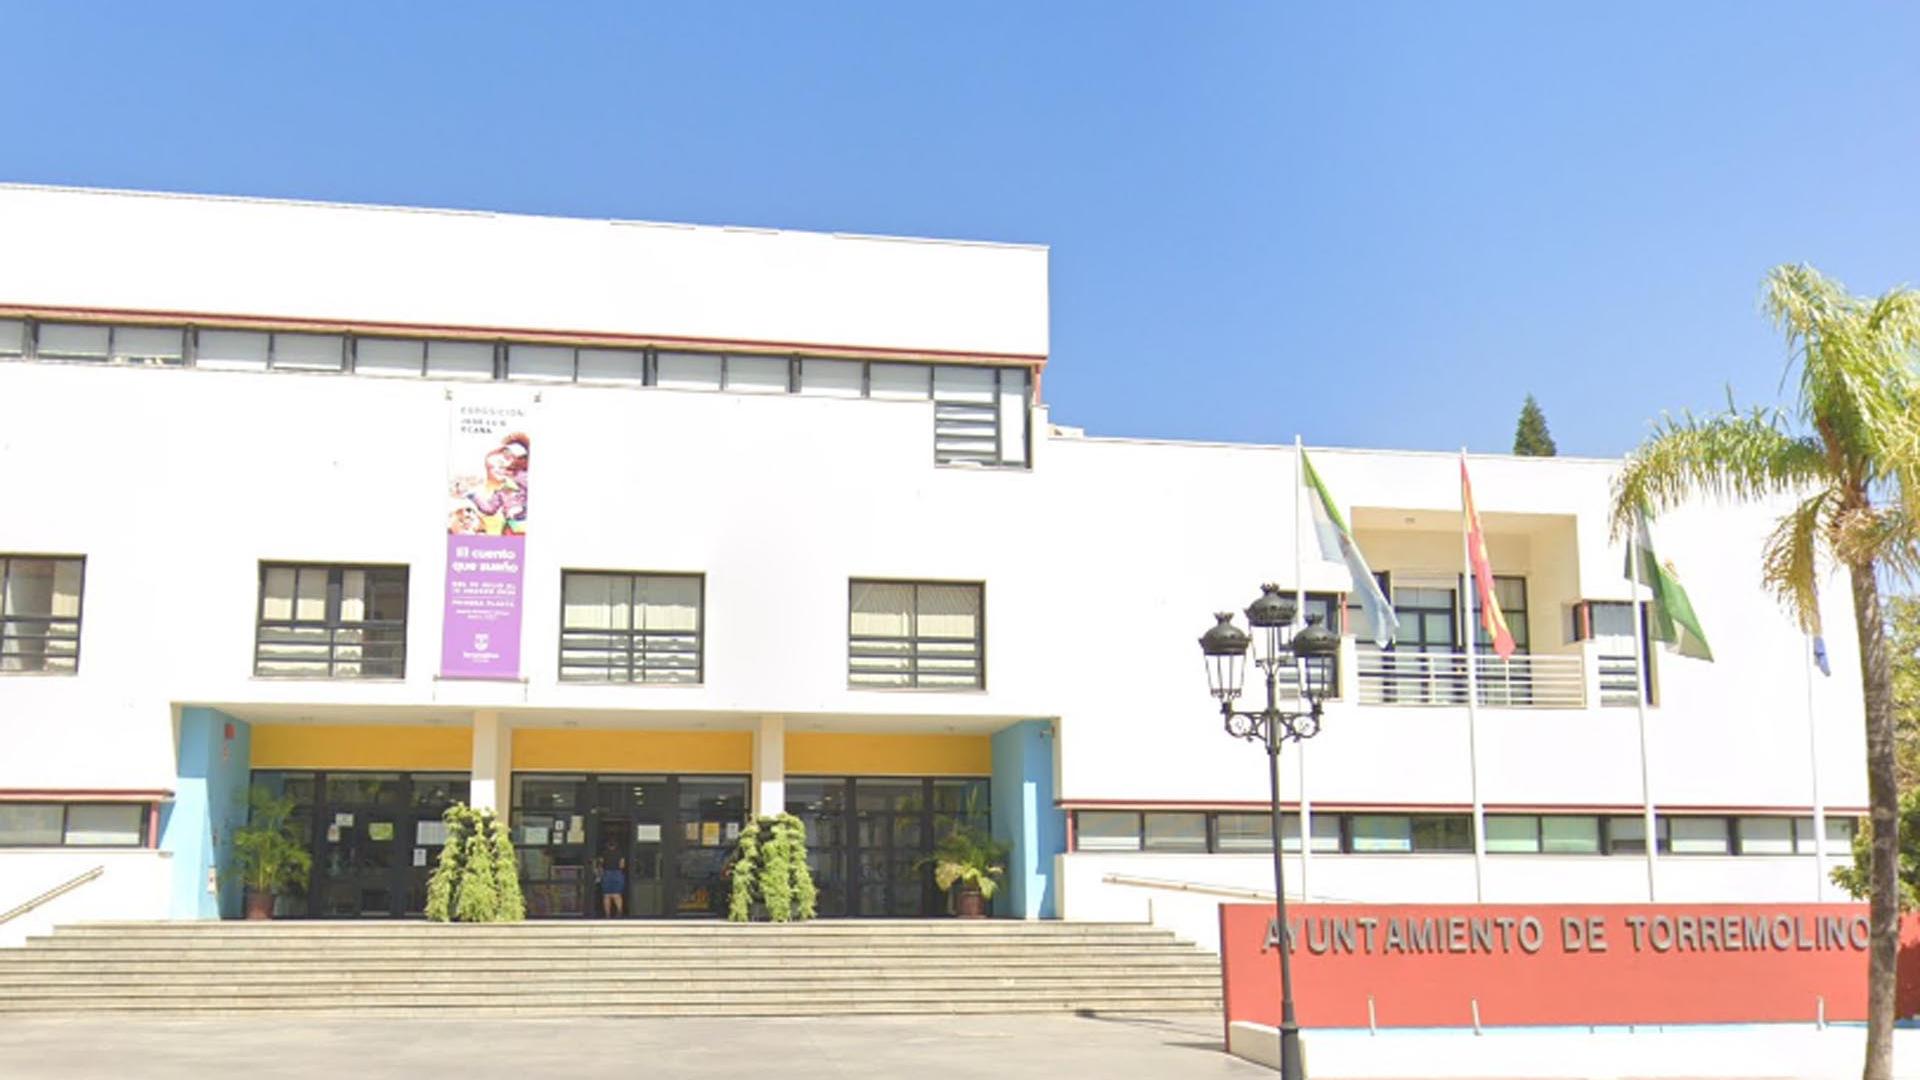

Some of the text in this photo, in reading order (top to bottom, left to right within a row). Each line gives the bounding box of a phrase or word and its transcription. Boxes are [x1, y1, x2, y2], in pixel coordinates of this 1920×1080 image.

[455, 546, 517, 560] El cuento
[451, 561, 477, 573] que
[1261, 913, 1872, 953] AYUNTAMIENTO DE TORREMOLINO
